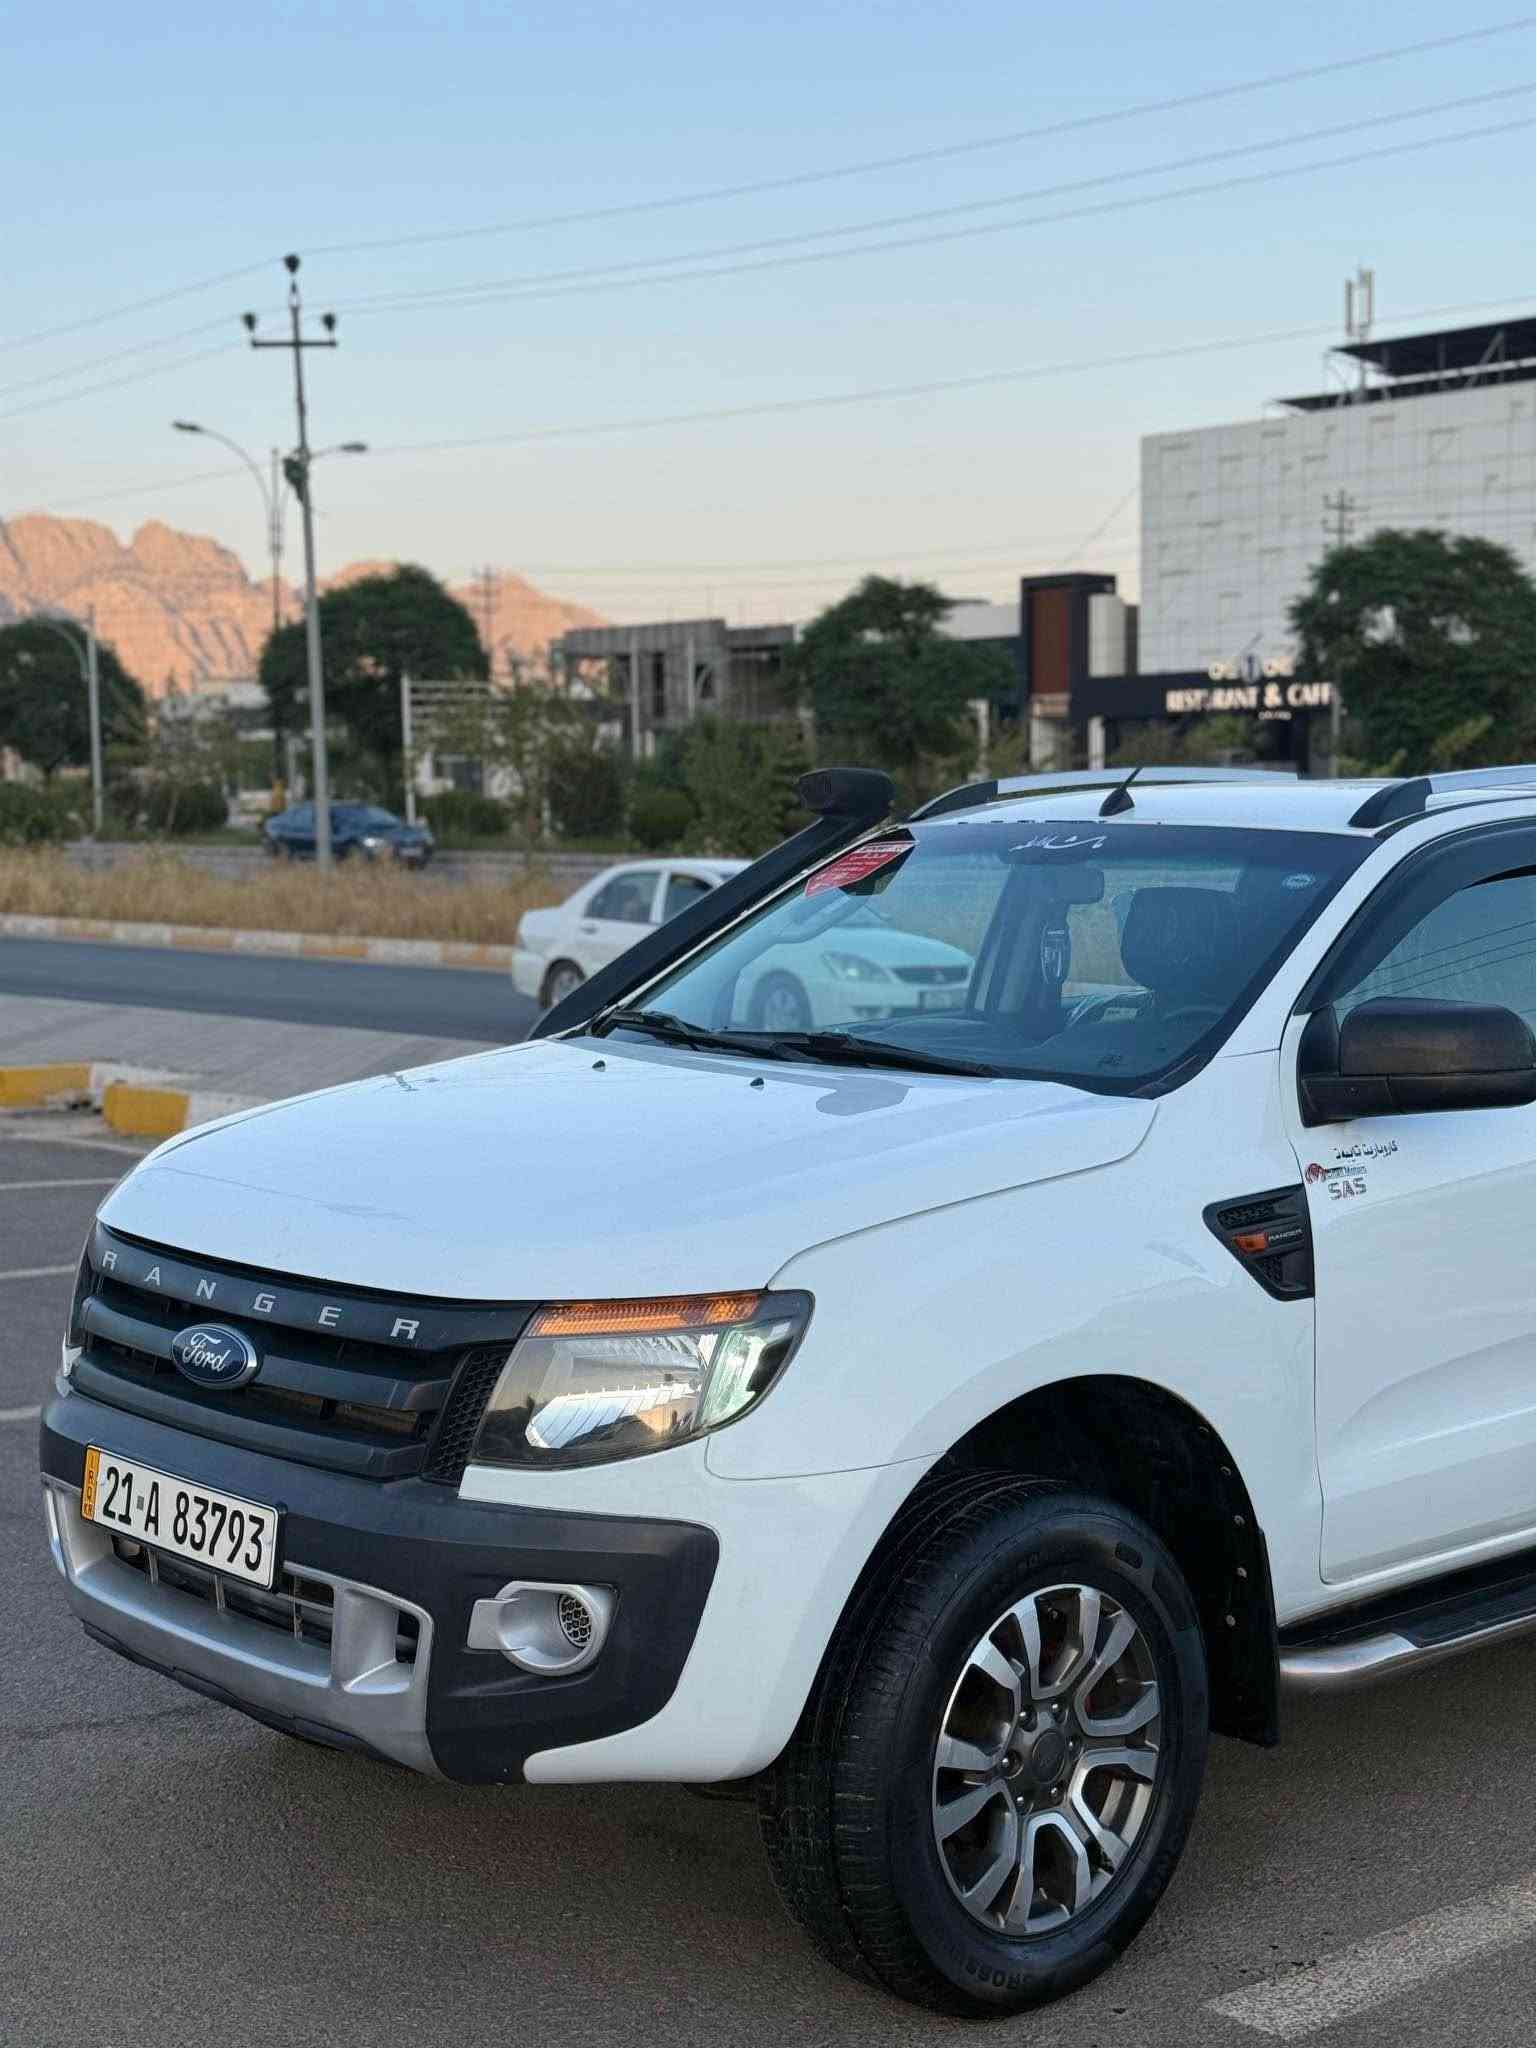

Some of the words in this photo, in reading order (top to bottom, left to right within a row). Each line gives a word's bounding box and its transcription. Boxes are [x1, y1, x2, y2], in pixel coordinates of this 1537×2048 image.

[1264, 681, 1283, 708] &
[1327, 1176, 1367, 1200] SAS
[101, 1250, 421, 1341] RANGER
[181, 1332, 231, 1373] Ford
[102, 1466, 134, 1526] 21
[143, 1481, 160, 1537] A
[172, 1491, 265, 1572] 83793
